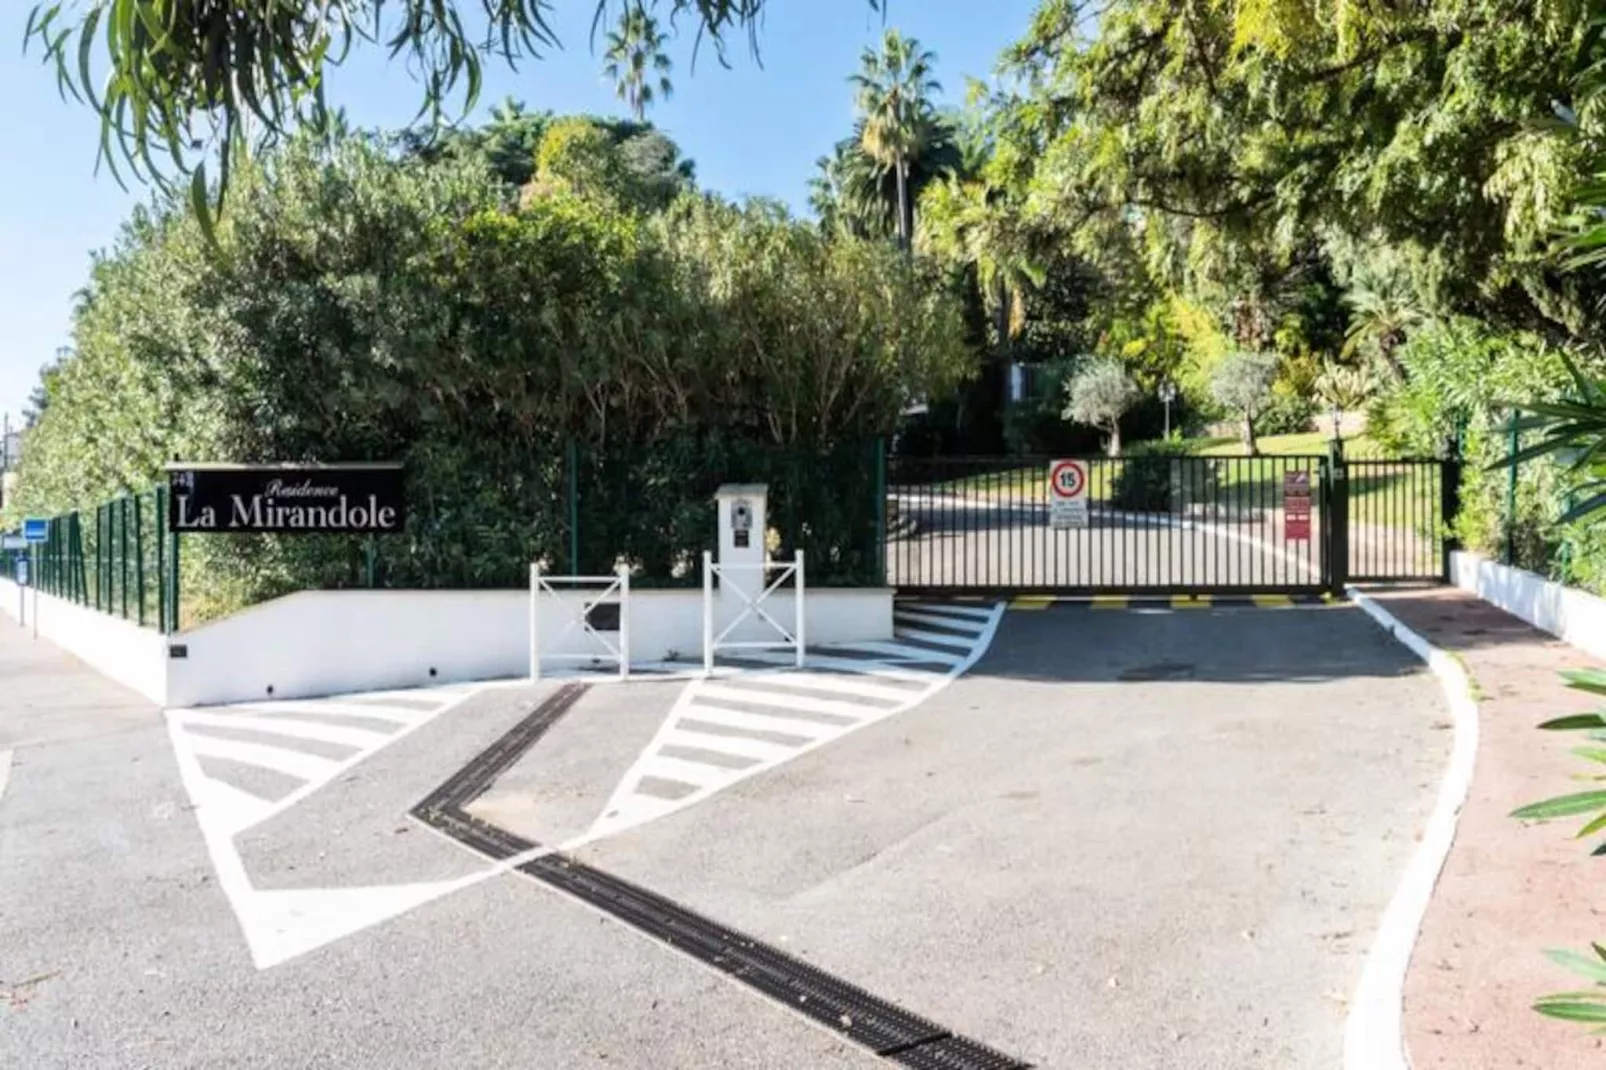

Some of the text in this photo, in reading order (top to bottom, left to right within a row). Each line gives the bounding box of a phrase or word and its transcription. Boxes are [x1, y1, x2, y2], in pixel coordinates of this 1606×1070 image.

[1061, 471, 1076, 487] 15
[176, 493, 396, 528] La Mirandole
